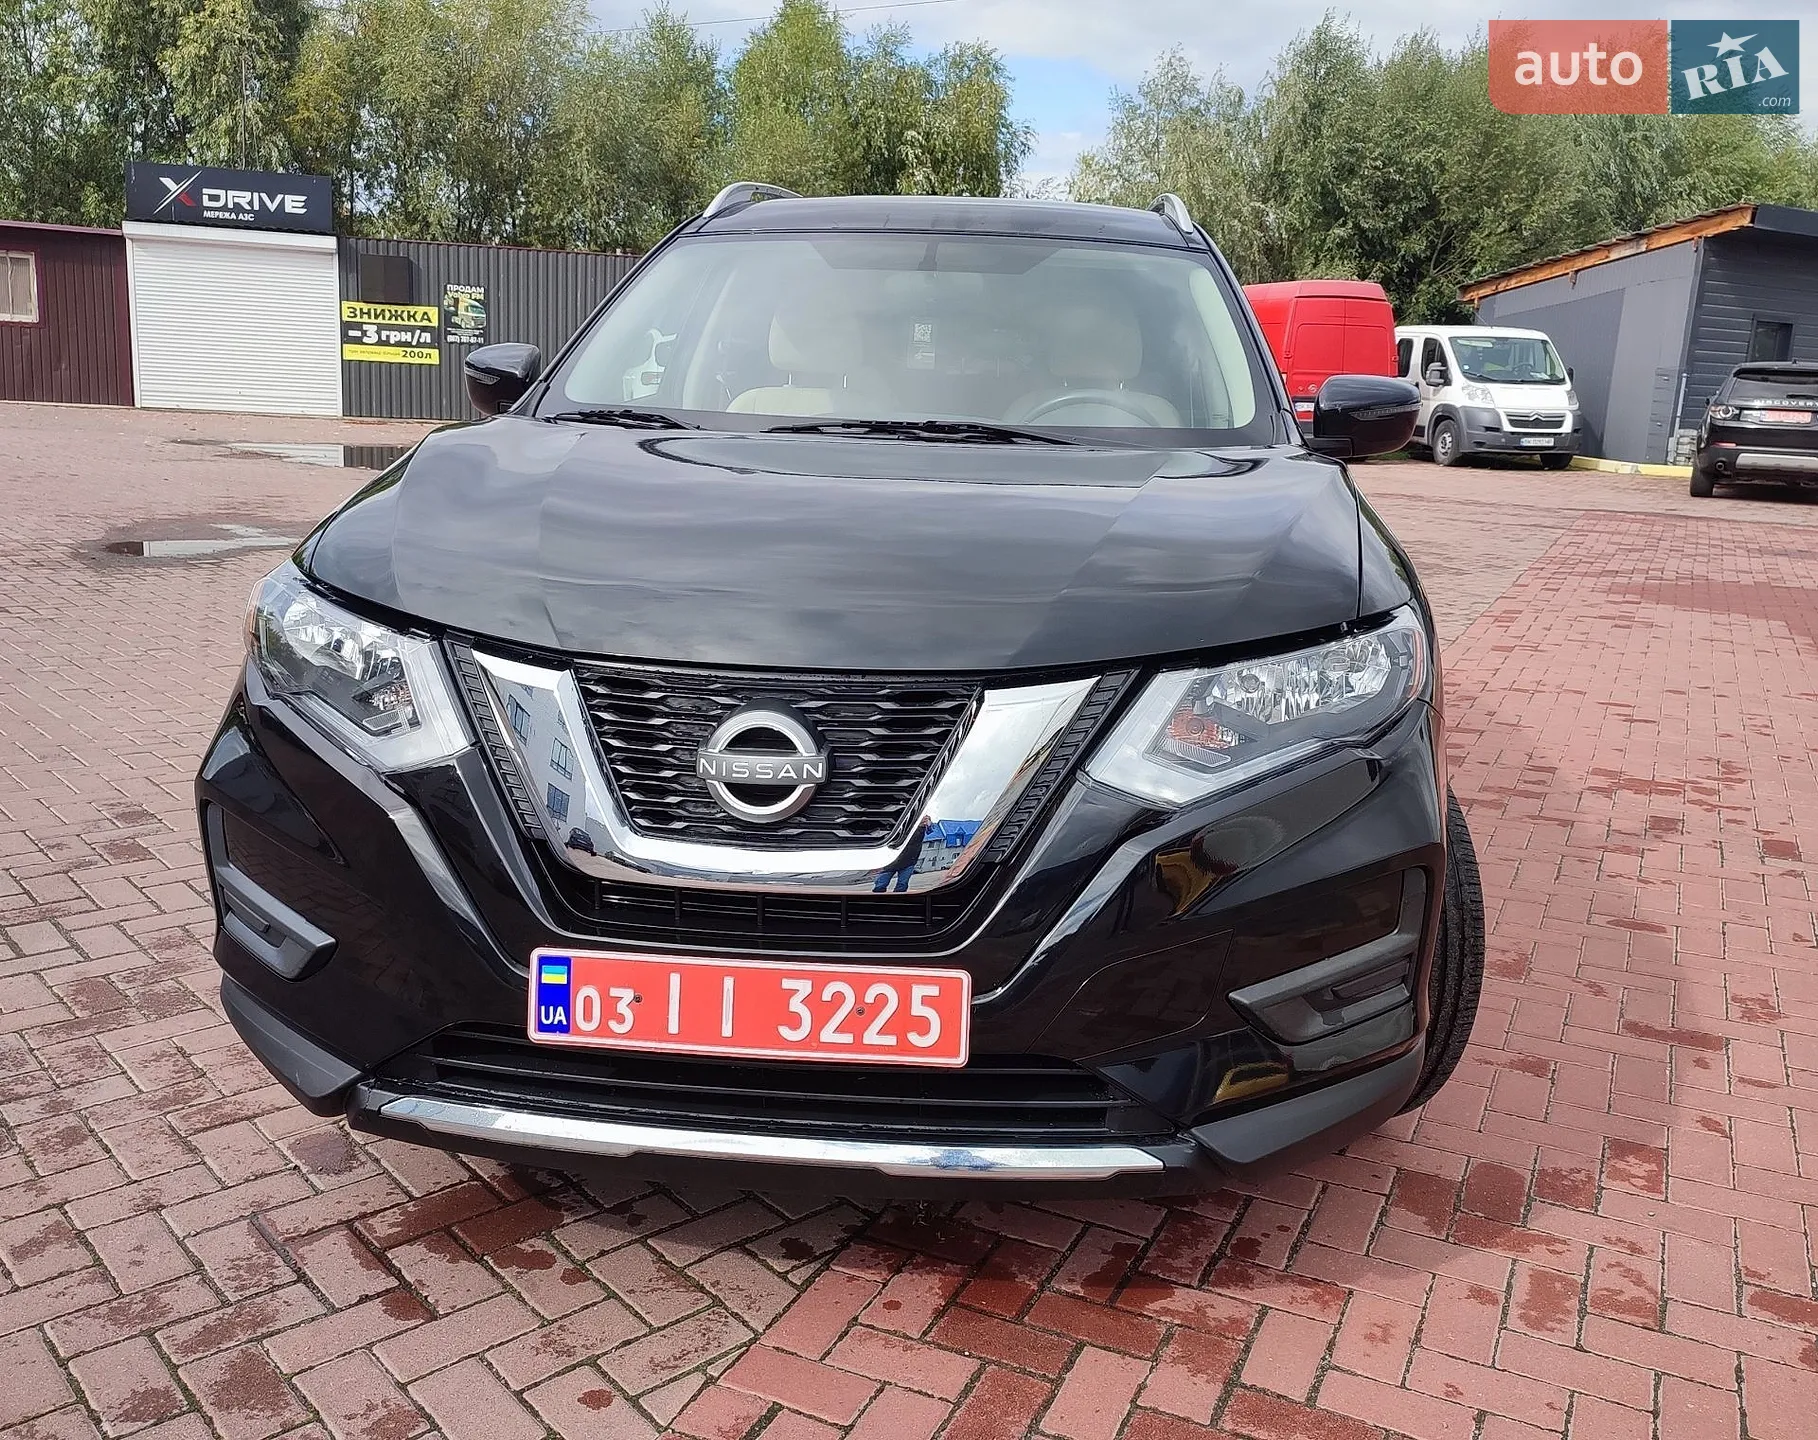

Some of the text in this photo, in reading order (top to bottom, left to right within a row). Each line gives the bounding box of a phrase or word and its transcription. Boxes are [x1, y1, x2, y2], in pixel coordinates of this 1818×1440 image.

[202, 188, 308, 214] DRIVE
[203, 210, 255, 221] МЕРЕЖА АЗС
[446, 284, 485, 294] ПРОДАМ
[346, 306, 433, 323] ЗНИЖКА
[381, 329, 432, 346] грн/л
[401, 349, 432, 359] 200л
[699, 757, 823, 779] NISSAN
[540, 1005, 568, 1025] UA
[574, 985, 635, 1035] 03
[776, 977, 942, 1049] 3225
